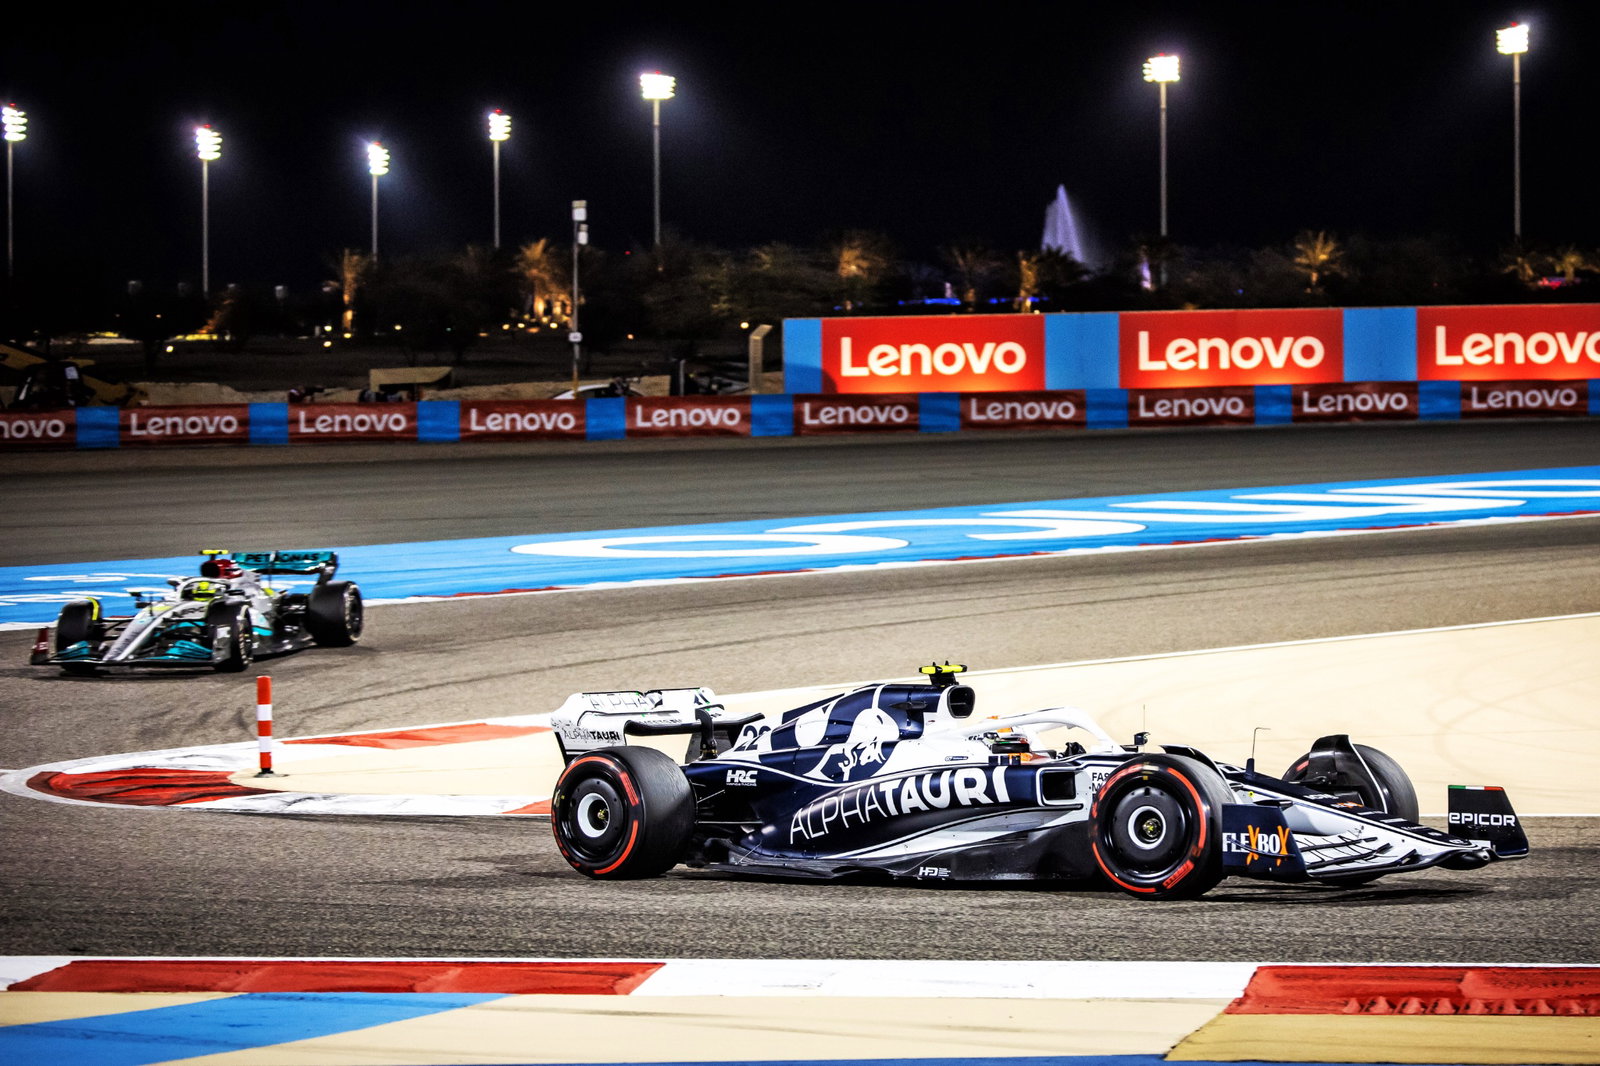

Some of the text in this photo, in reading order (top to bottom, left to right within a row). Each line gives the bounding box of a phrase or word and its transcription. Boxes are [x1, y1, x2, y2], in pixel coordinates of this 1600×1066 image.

[841, 337, 1026, 377] Lenovo
[1138, 331, 1324, 371] Lenovo
[970, 398, 1076, 421] Lenovo
[1138, 395, 1245, 418] Lenovo
[1302, 391, 1408, 413] Lenovo
[1471, 386, 1577, 410] Lenovo
[130, 413, 238, 436] Lenovo
[299, 411, 407, 433] Lenovo
[470, 408, 576, 431] Lenovo
[636, 405, 741, 427] Lenovo
[803, 402, 909, 425] Lenovo
[0, 419, 65, 439] novo
[726, 769, 758, 783] HRC
[790, 765, 1011, 845] ALPHATAURI
